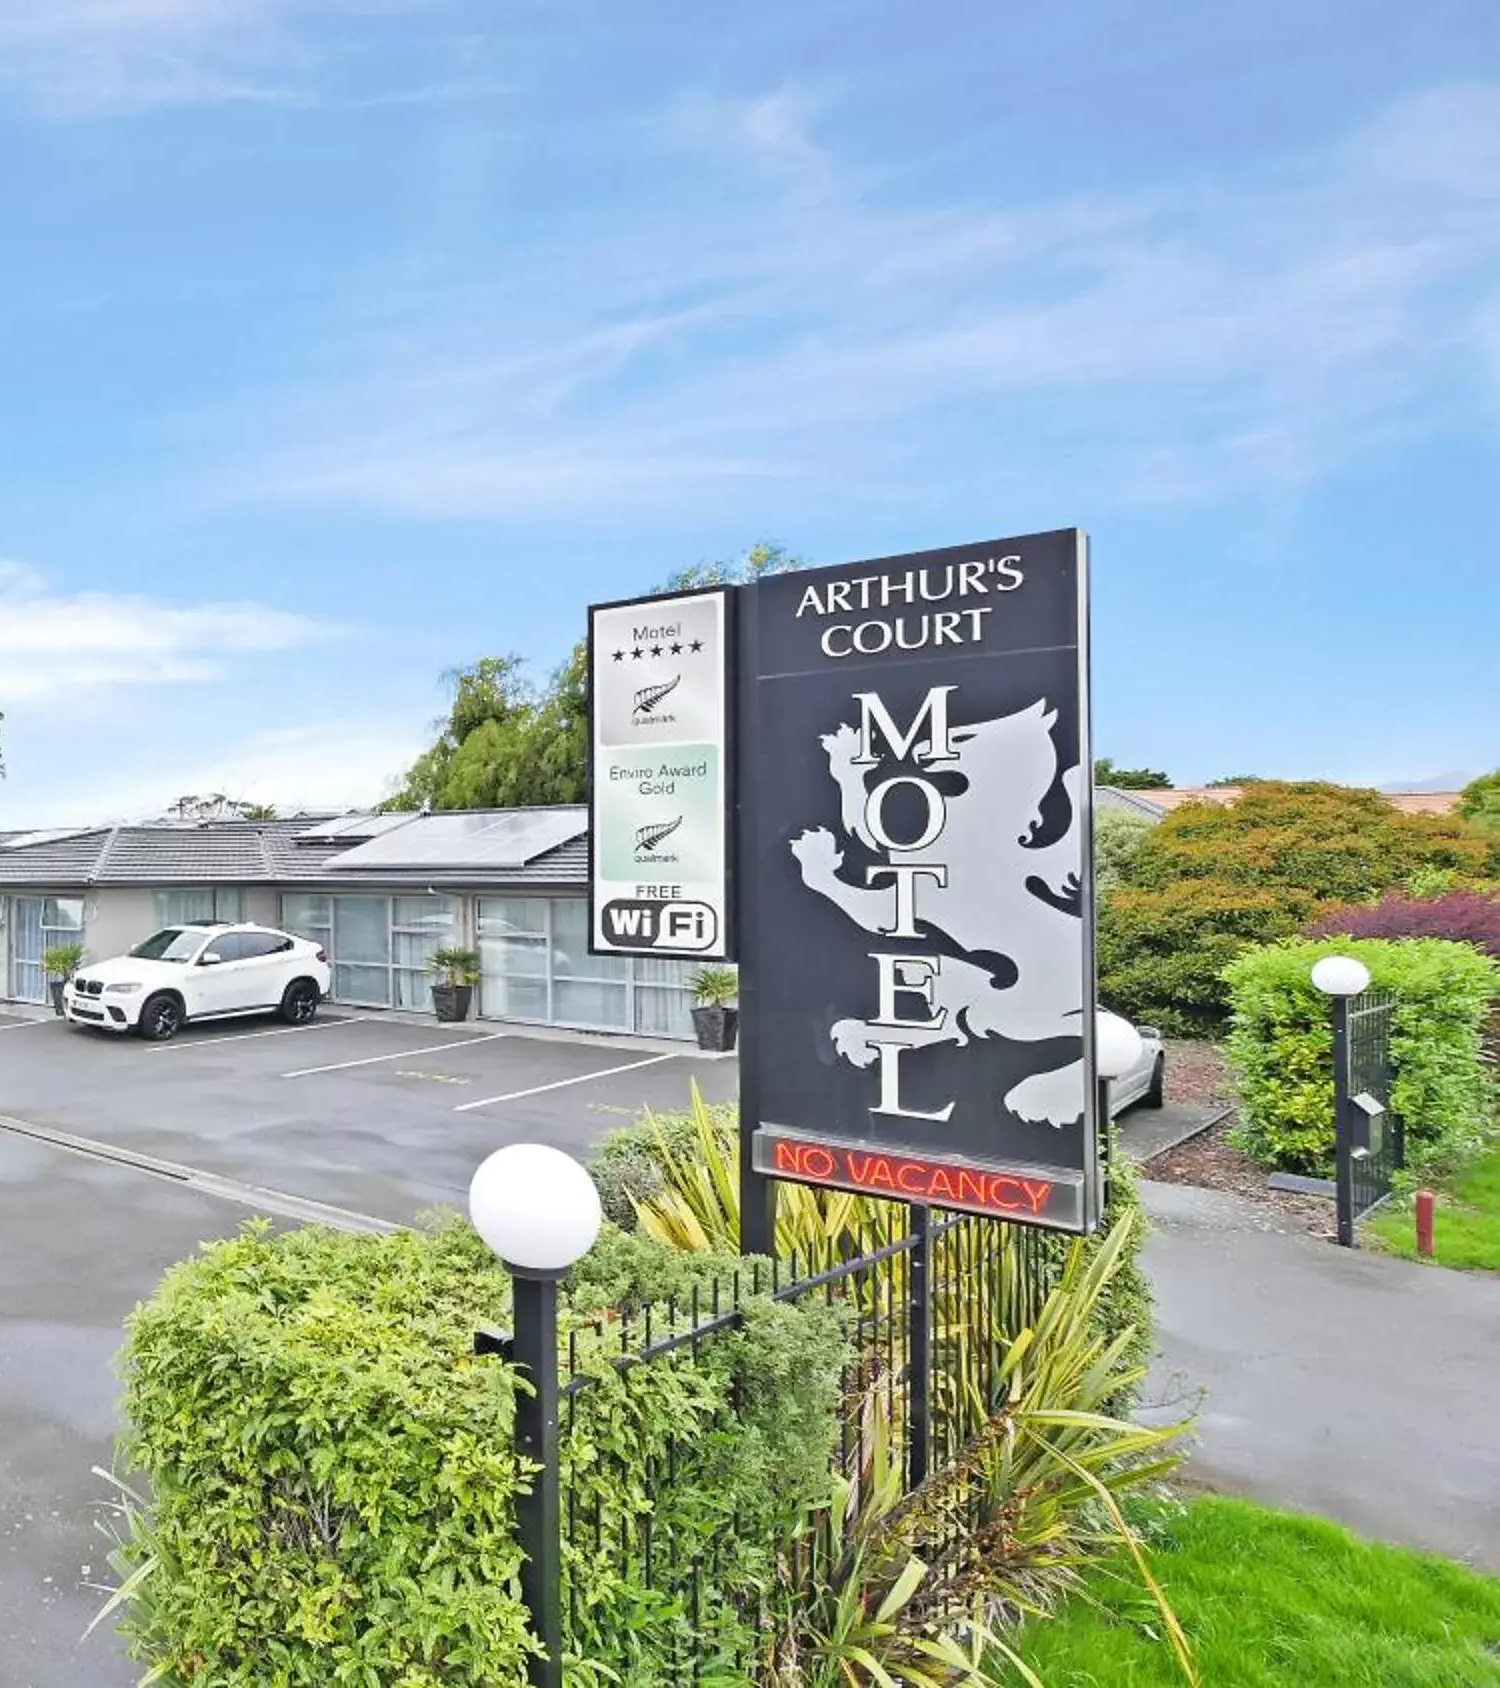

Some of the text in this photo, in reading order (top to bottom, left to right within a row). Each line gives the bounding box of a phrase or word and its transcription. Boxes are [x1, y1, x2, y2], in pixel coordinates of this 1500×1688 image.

[795, 554, 1025, 619] ARTHUR'S
[632, 622, 682, 641] Motel
[820, 606, 993, 658] COURT
[609, 762, 708, 781] Enviro Award
[638, 781, 676, 796] Gold
[635, 885, 682, 899] FREE
[850, 684, 961, 1123] MOTEL
[775, 1141, 1053, 1215] NO VACANCY
